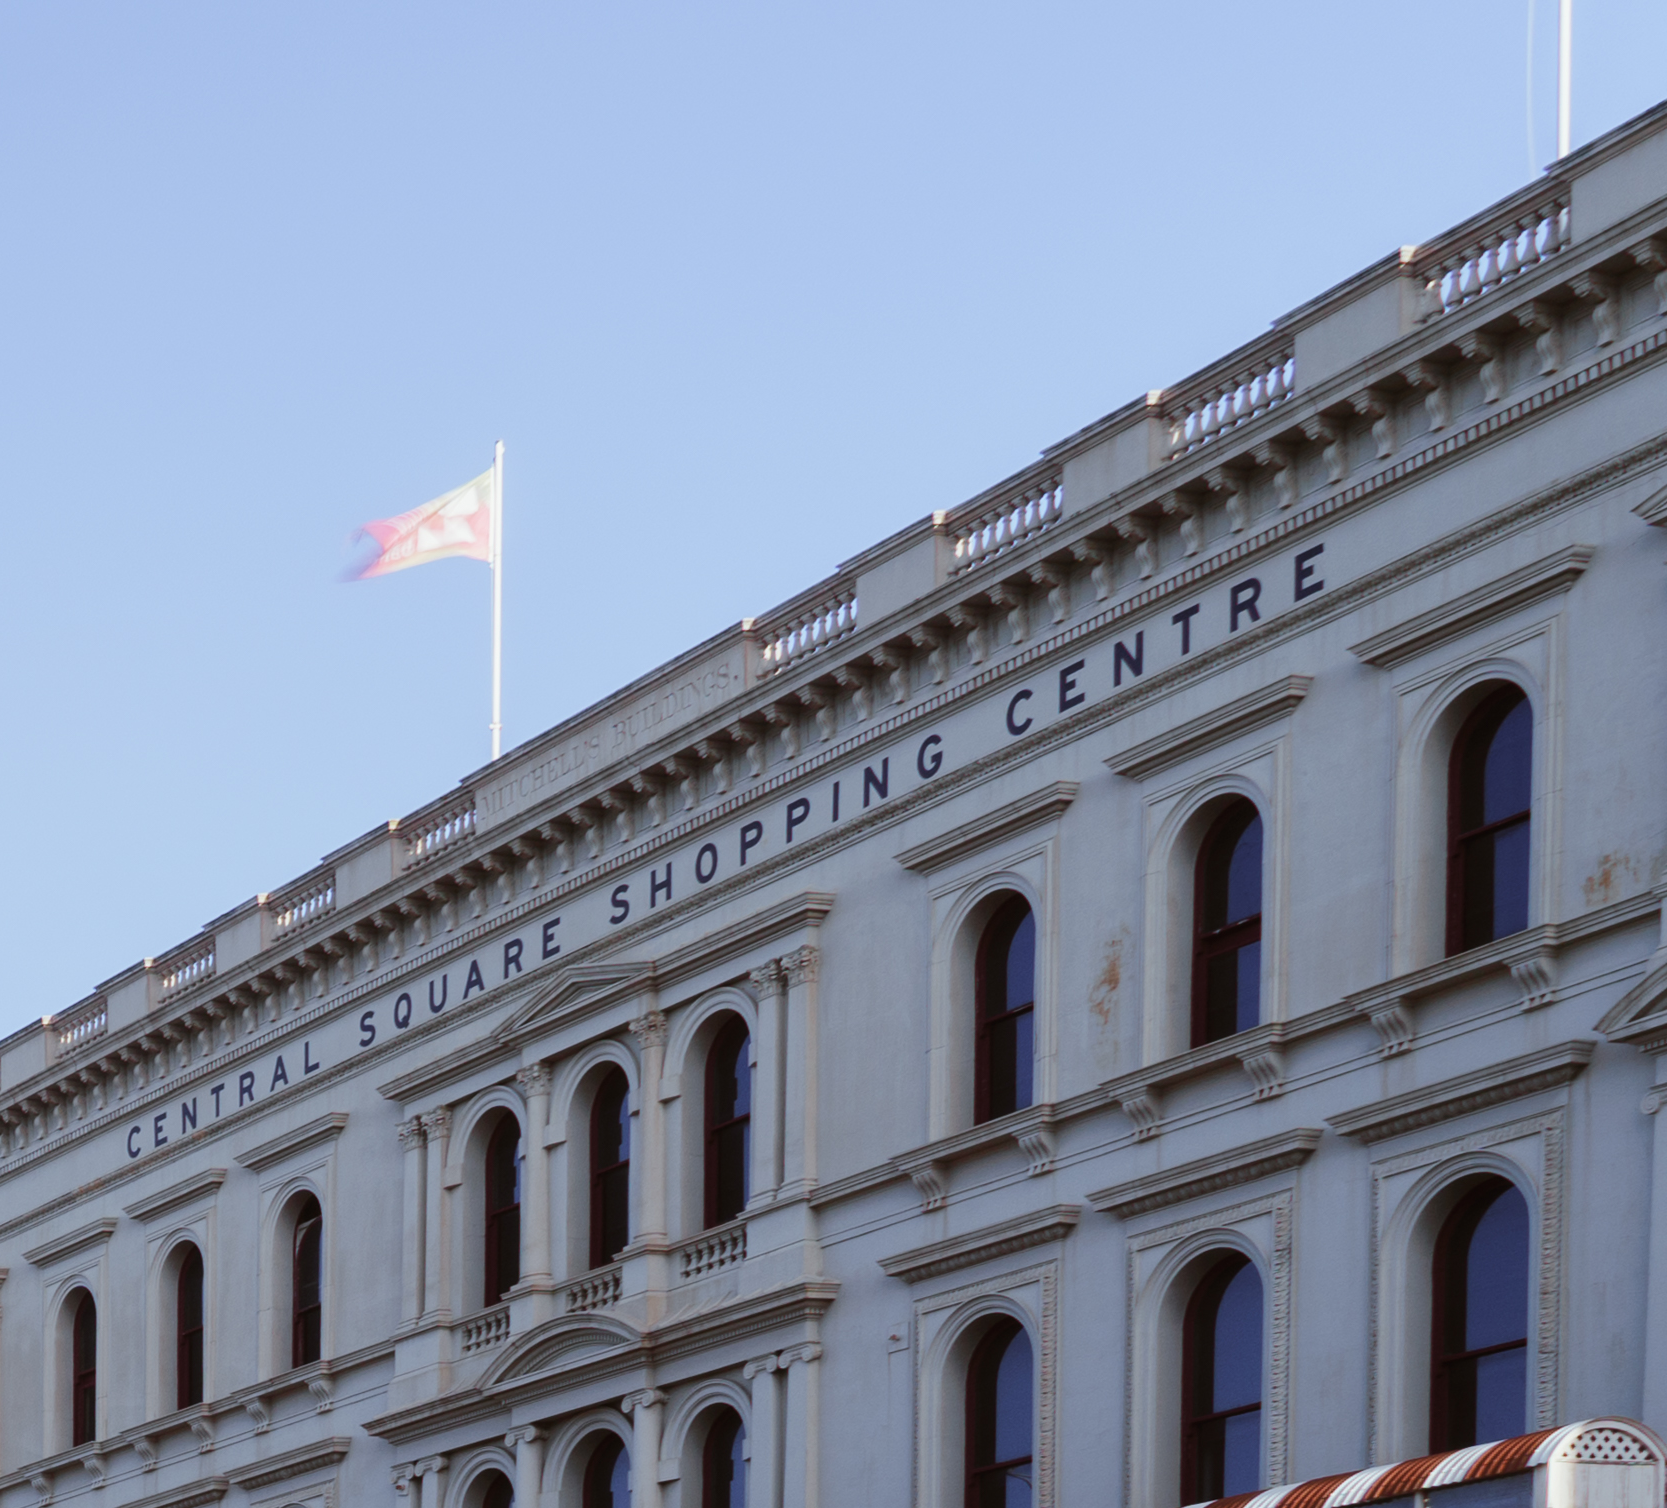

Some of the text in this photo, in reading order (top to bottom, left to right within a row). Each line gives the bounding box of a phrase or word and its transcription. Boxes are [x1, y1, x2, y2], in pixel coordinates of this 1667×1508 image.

[127, 543, 1325, 1158] CENTRAL SQUARE SHOPPING CENTRE
